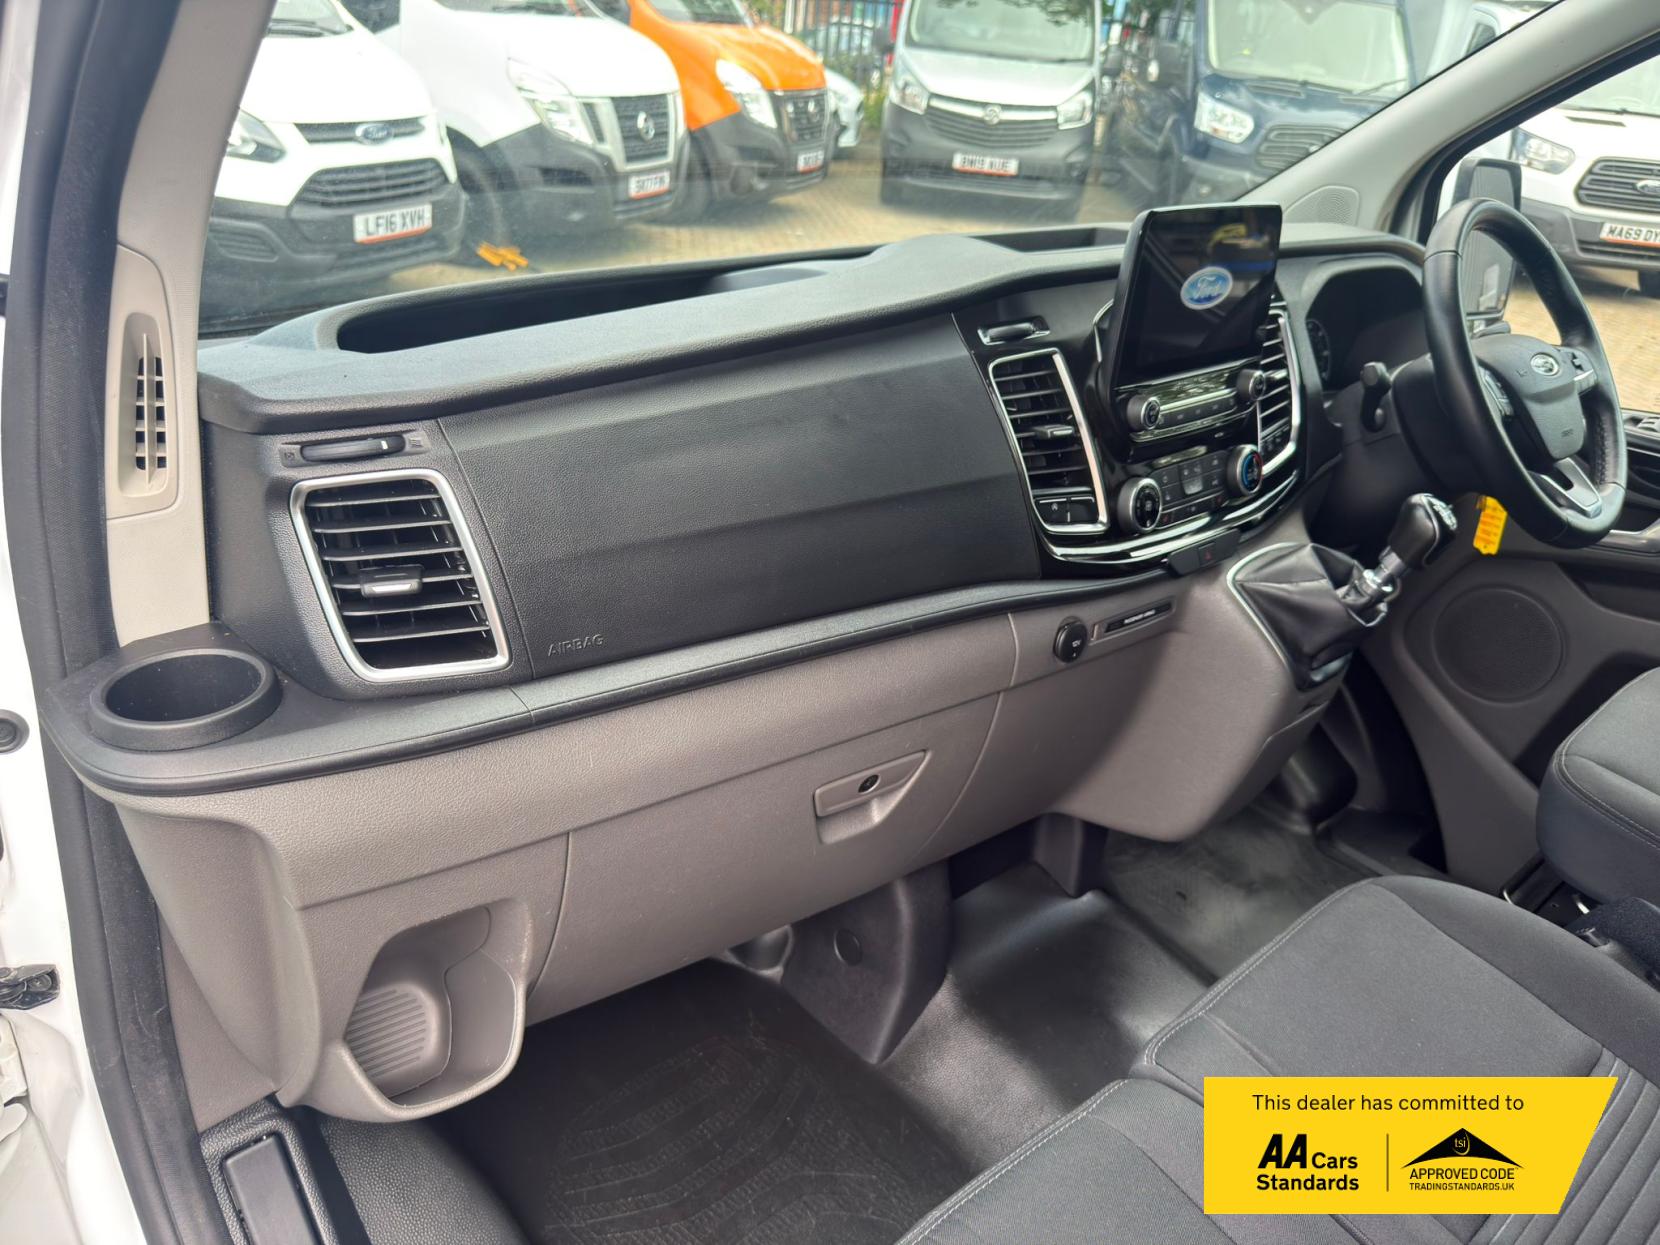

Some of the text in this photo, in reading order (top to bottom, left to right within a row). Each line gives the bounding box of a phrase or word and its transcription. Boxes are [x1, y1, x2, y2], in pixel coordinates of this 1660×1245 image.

[365, 207, 425, 236] LF16 XVH
[1607, 225, 1642, 241] MA69
[547, 633, 604, 657] AIRBAG
